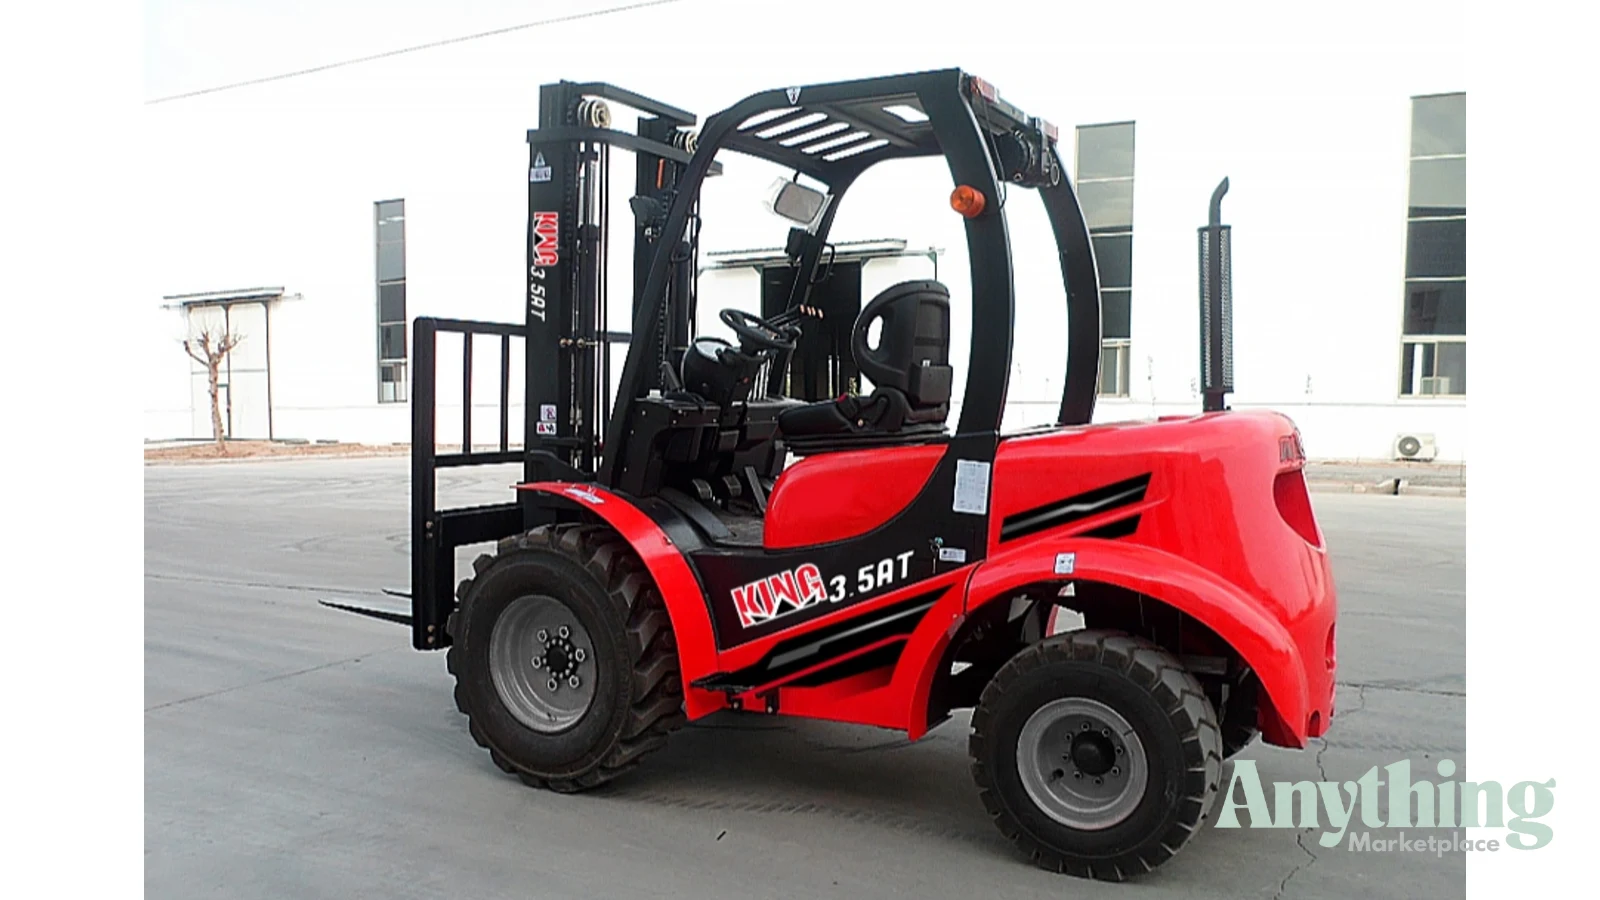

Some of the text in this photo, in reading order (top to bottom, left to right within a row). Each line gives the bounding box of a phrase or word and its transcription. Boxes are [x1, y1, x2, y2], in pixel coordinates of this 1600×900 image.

[530, 212, 559, 322] KING 3.5AT
[731, 550, 915, 628] KING 3.5AT
